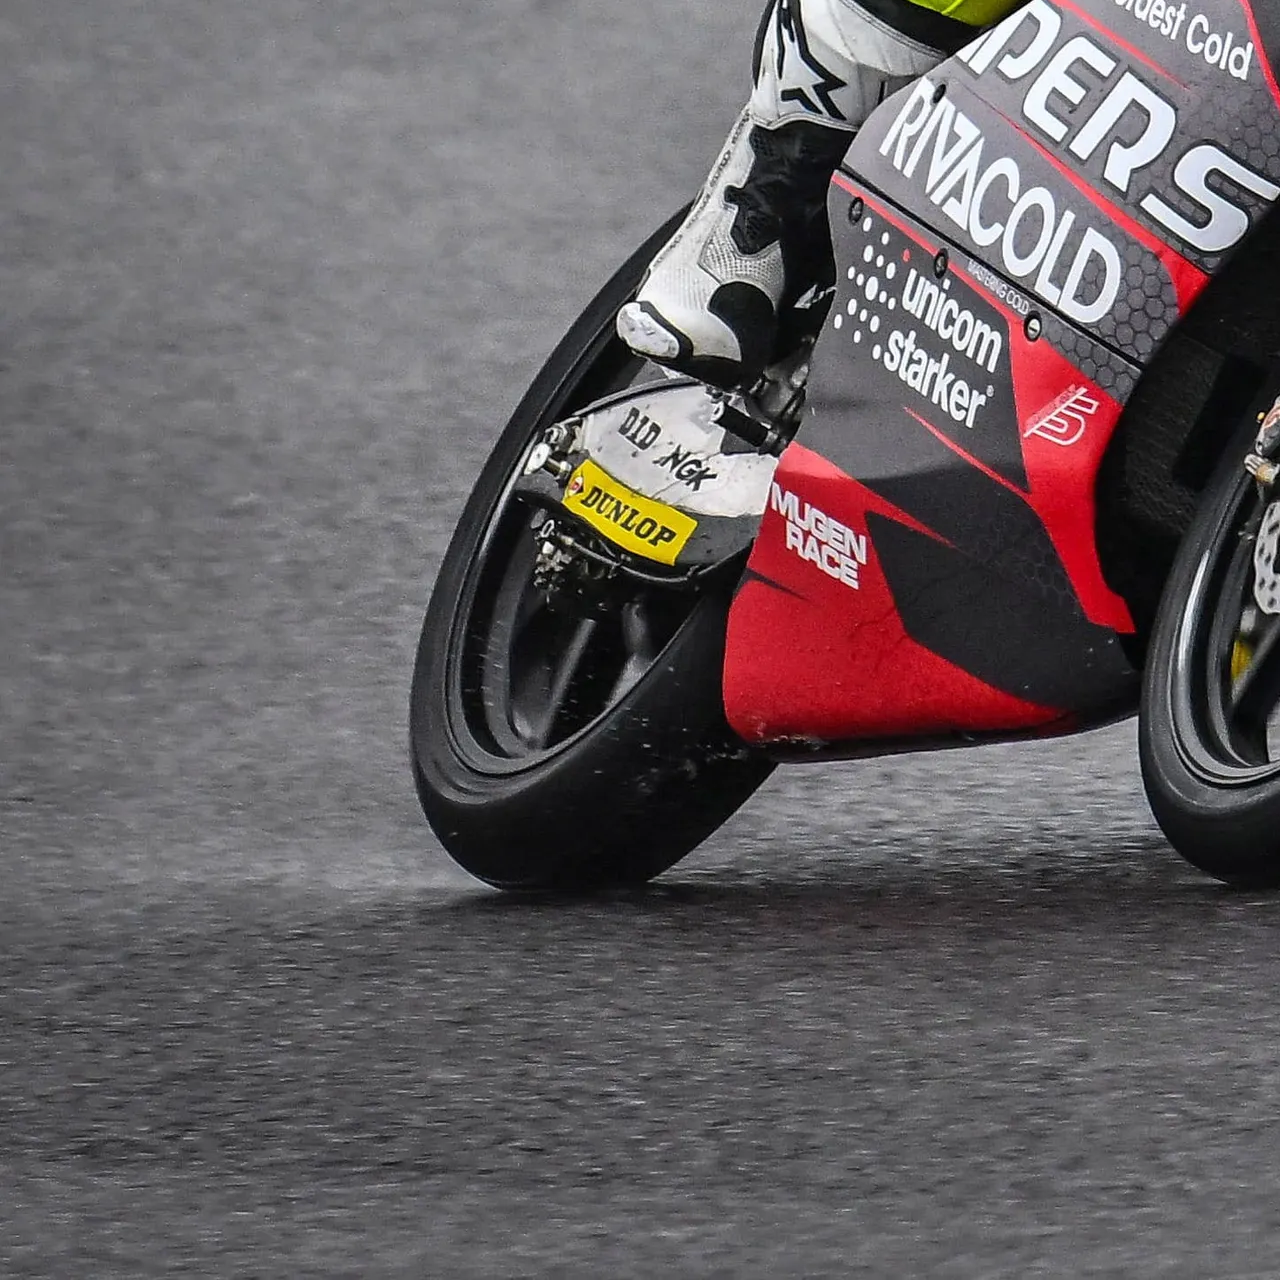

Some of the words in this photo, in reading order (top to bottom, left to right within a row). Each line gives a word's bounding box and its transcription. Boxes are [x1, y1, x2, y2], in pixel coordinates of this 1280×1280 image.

[1185, 14, 1254, 82] Cold
[879, 77, 1122, 324] RIVACOLD
[902, 268, 1003, 373] unicom
[618, 407, 662, 450] DID
[658, 444, 718, 492] NGK
[580, 485, 677, 547] DUNLOP
[771, 481, 867, 565] MUGEN
[786, 520, 859, 590] RACE
